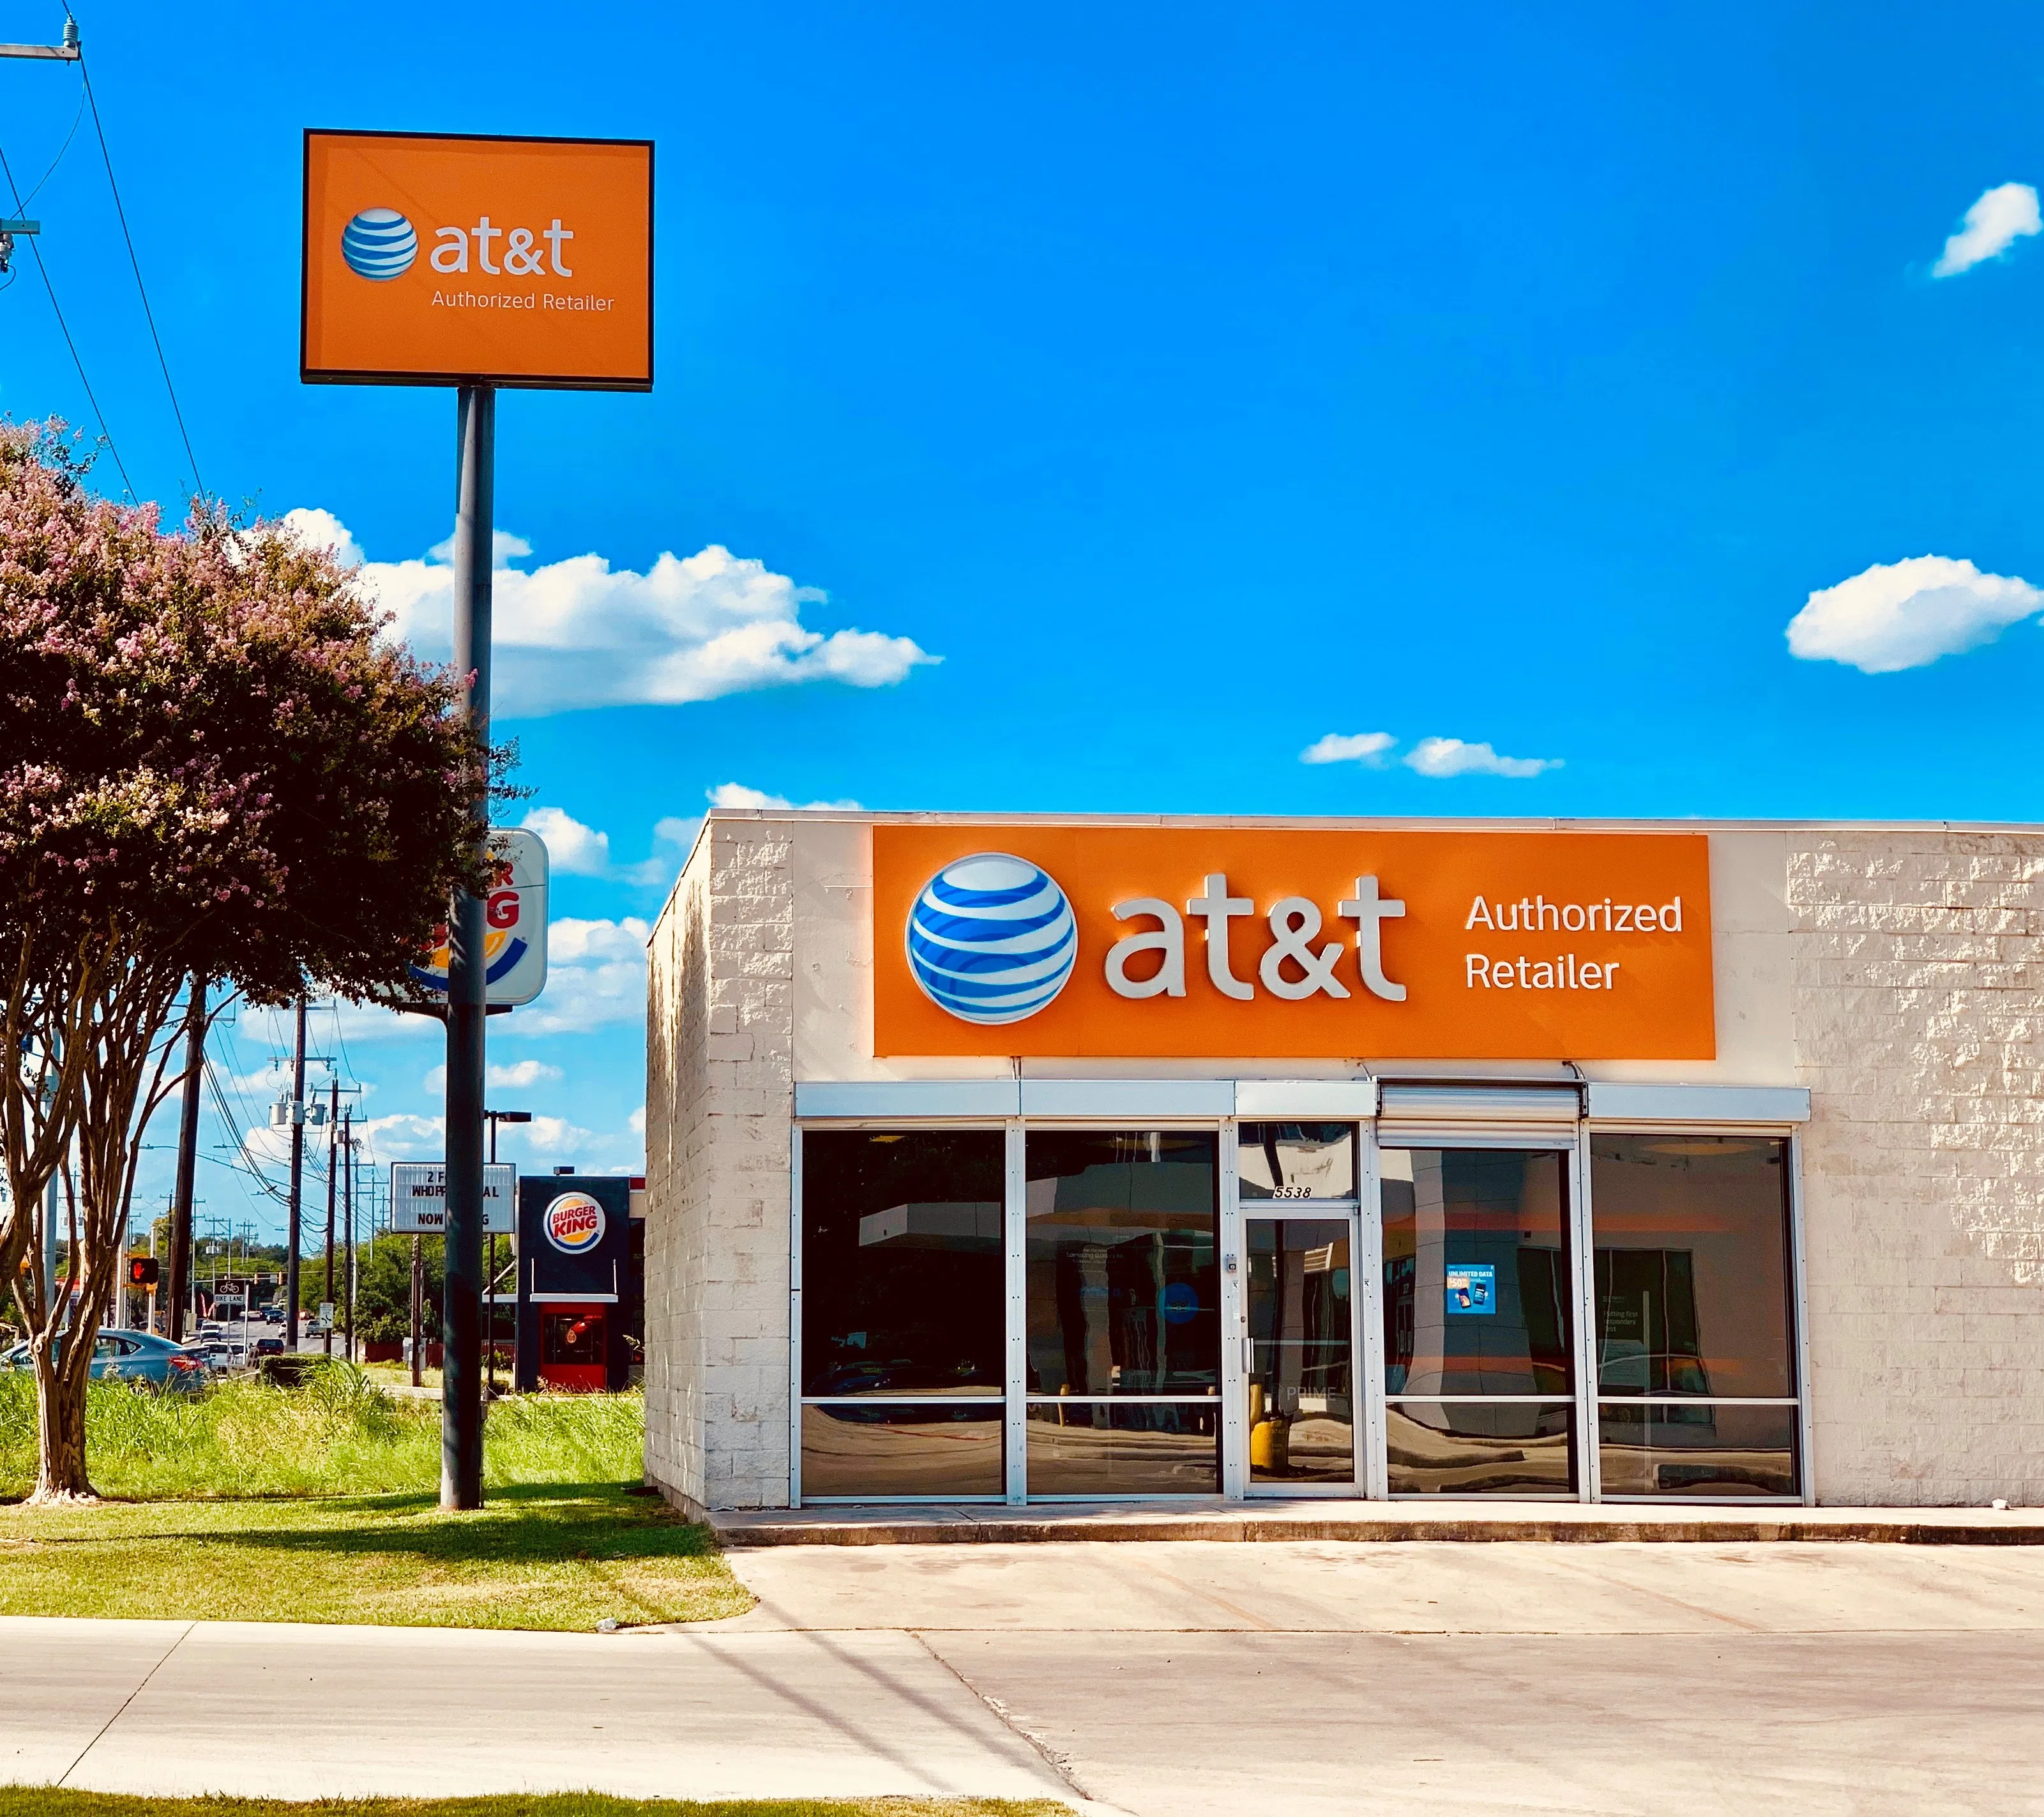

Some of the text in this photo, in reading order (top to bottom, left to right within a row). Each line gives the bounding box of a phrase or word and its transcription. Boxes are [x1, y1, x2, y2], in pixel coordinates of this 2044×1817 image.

[430, 217, 574, 277] at&t
[432, 291, 615, 311] Authorized Retailer
[1465, 895, 1683, 932] Authorized
[1105, 874, 1407, 1001] at&t
[1465, 953, 1620, 989] Retailer
[427, 1171, 434, 1183] 2
[1275, 1187, 1312, 1198] 5538
[418, 1213, 443, 1225] NOW
[552, 1206, 596, 1224] BURGER
[554, 1215, 598, 1238] KING
